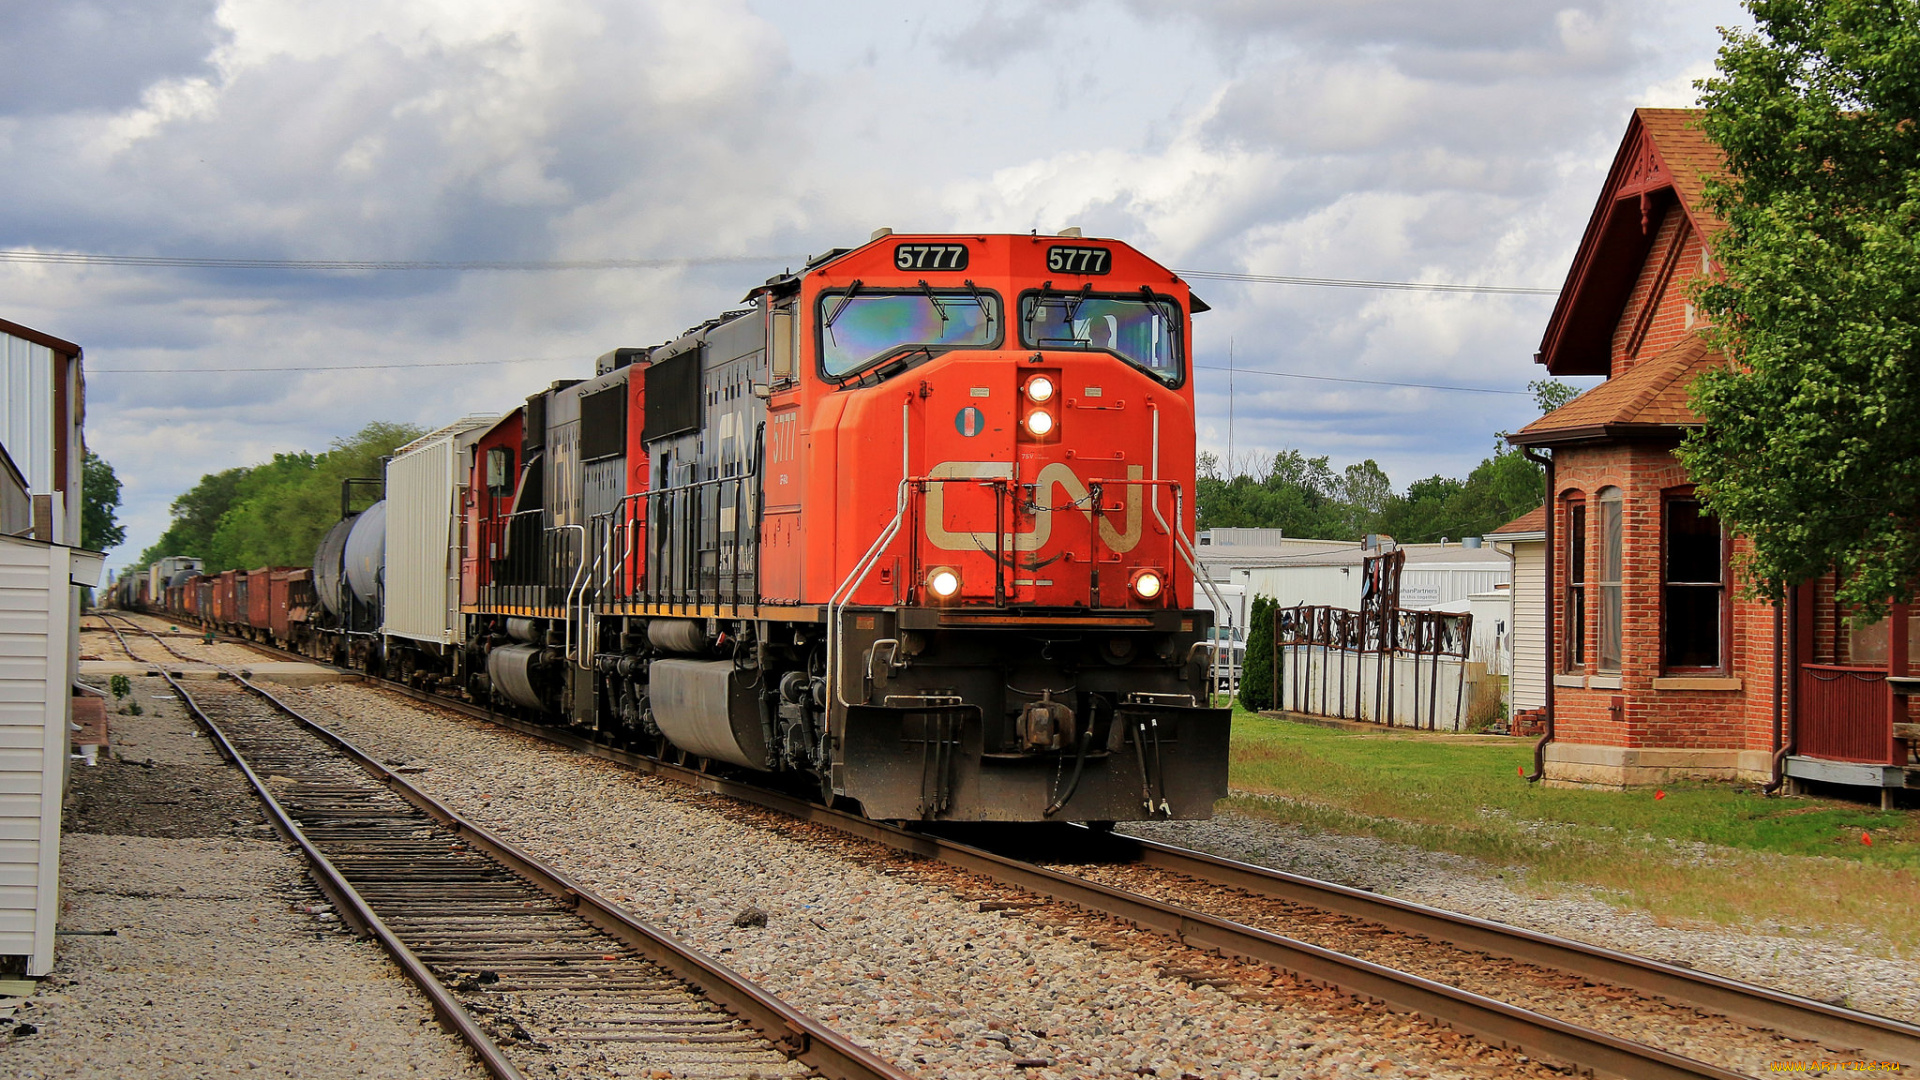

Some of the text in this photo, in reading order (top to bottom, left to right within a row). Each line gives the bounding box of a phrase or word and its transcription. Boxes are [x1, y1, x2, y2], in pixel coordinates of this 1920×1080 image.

[897, 246, 963, 268] 5777
[1049, 248, 1107, 272] 5777
[773, 411, 797, 464] 5777
[717, 406, 756, 533] CN
[925, 461, 1143, 553] CN
